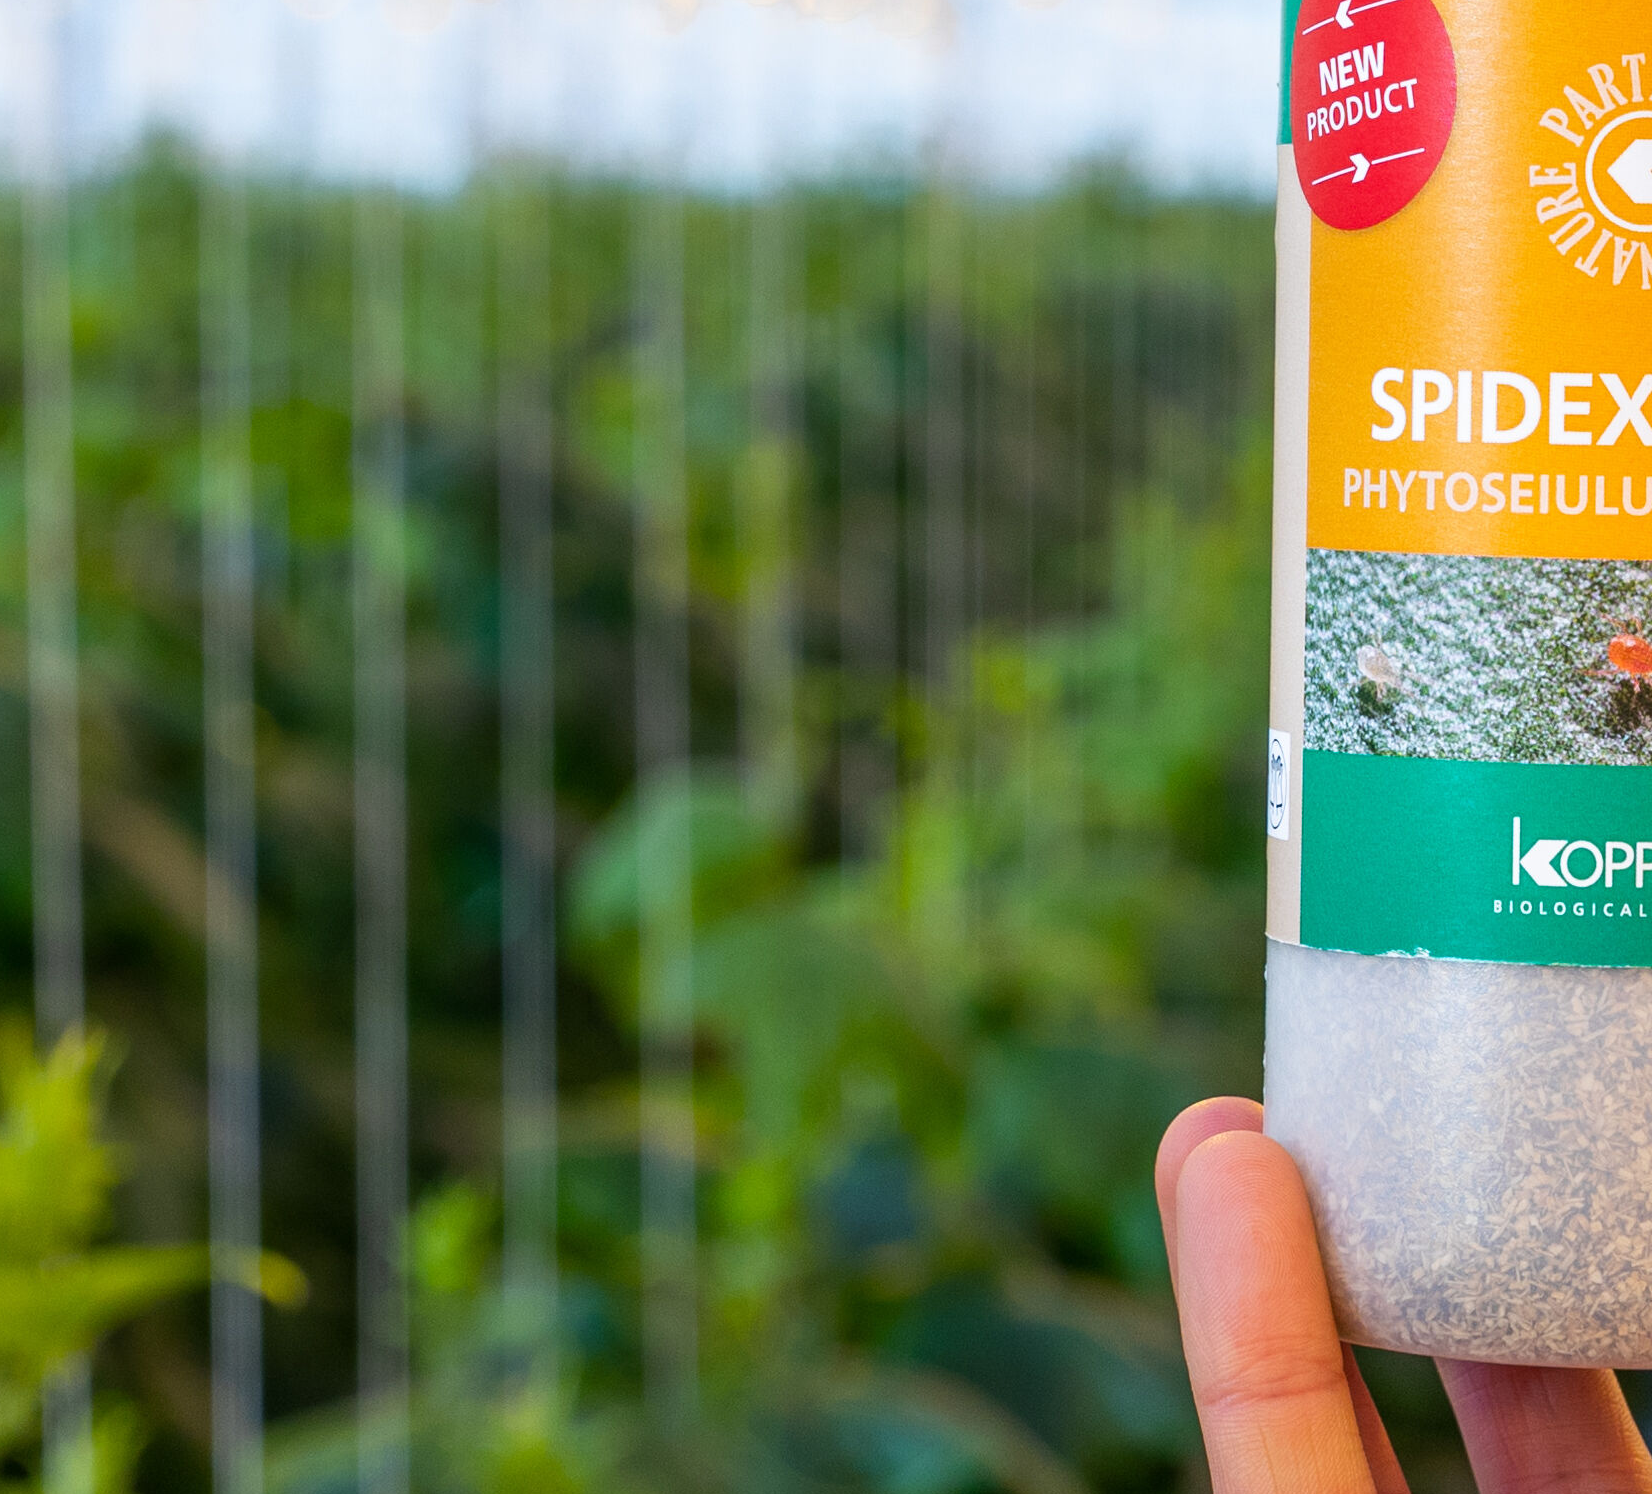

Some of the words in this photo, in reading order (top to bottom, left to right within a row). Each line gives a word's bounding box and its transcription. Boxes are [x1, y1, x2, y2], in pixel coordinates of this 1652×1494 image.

[1318, 41, 1385, 97] NEW
[1306, 77, 1418, 142] PRODUCT
[1492, 899, 1647, 918] BIOLOGICAL
